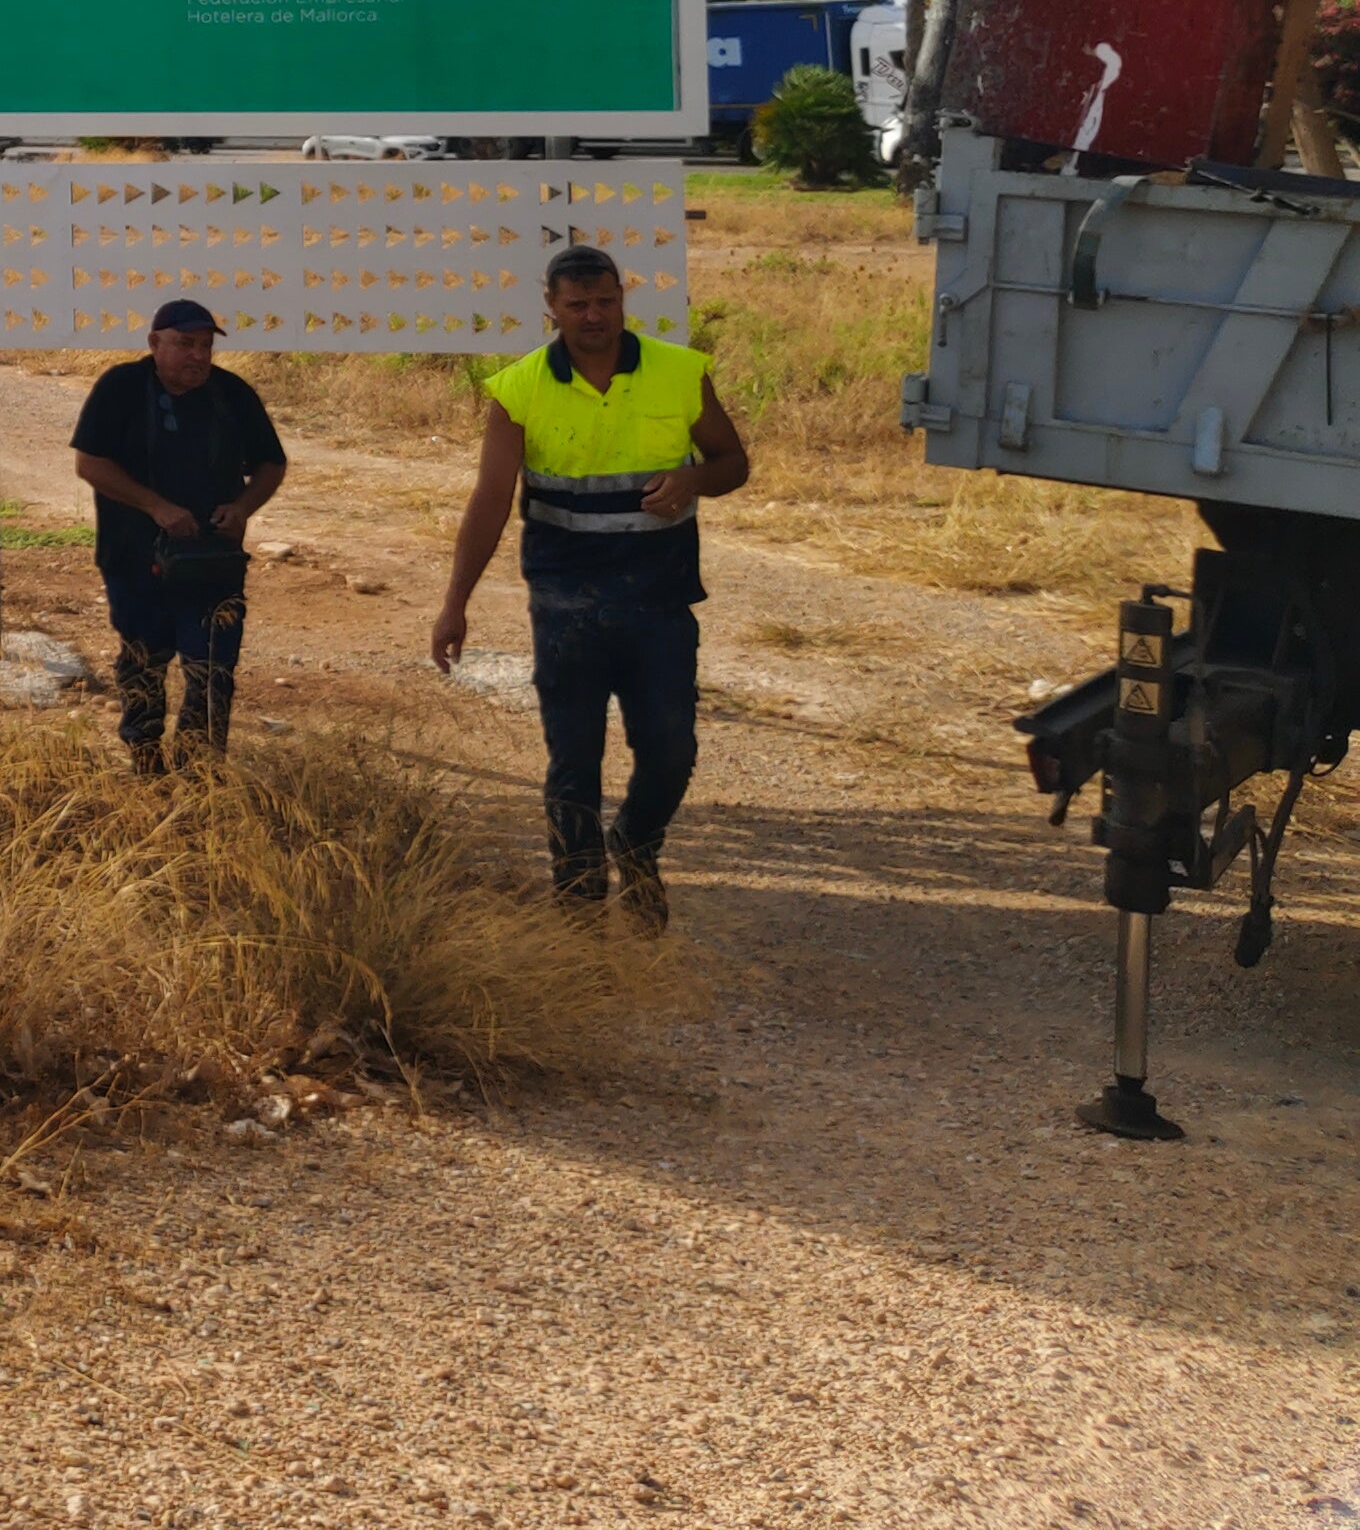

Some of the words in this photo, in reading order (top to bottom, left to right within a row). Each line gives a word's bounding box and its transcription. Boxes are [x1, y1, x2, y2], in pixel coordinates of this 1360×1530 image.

[187, 9, 265, 23] Hotelera
[271, 9, 293, 23] de
[300, 8, 378, 22] Mallorca
